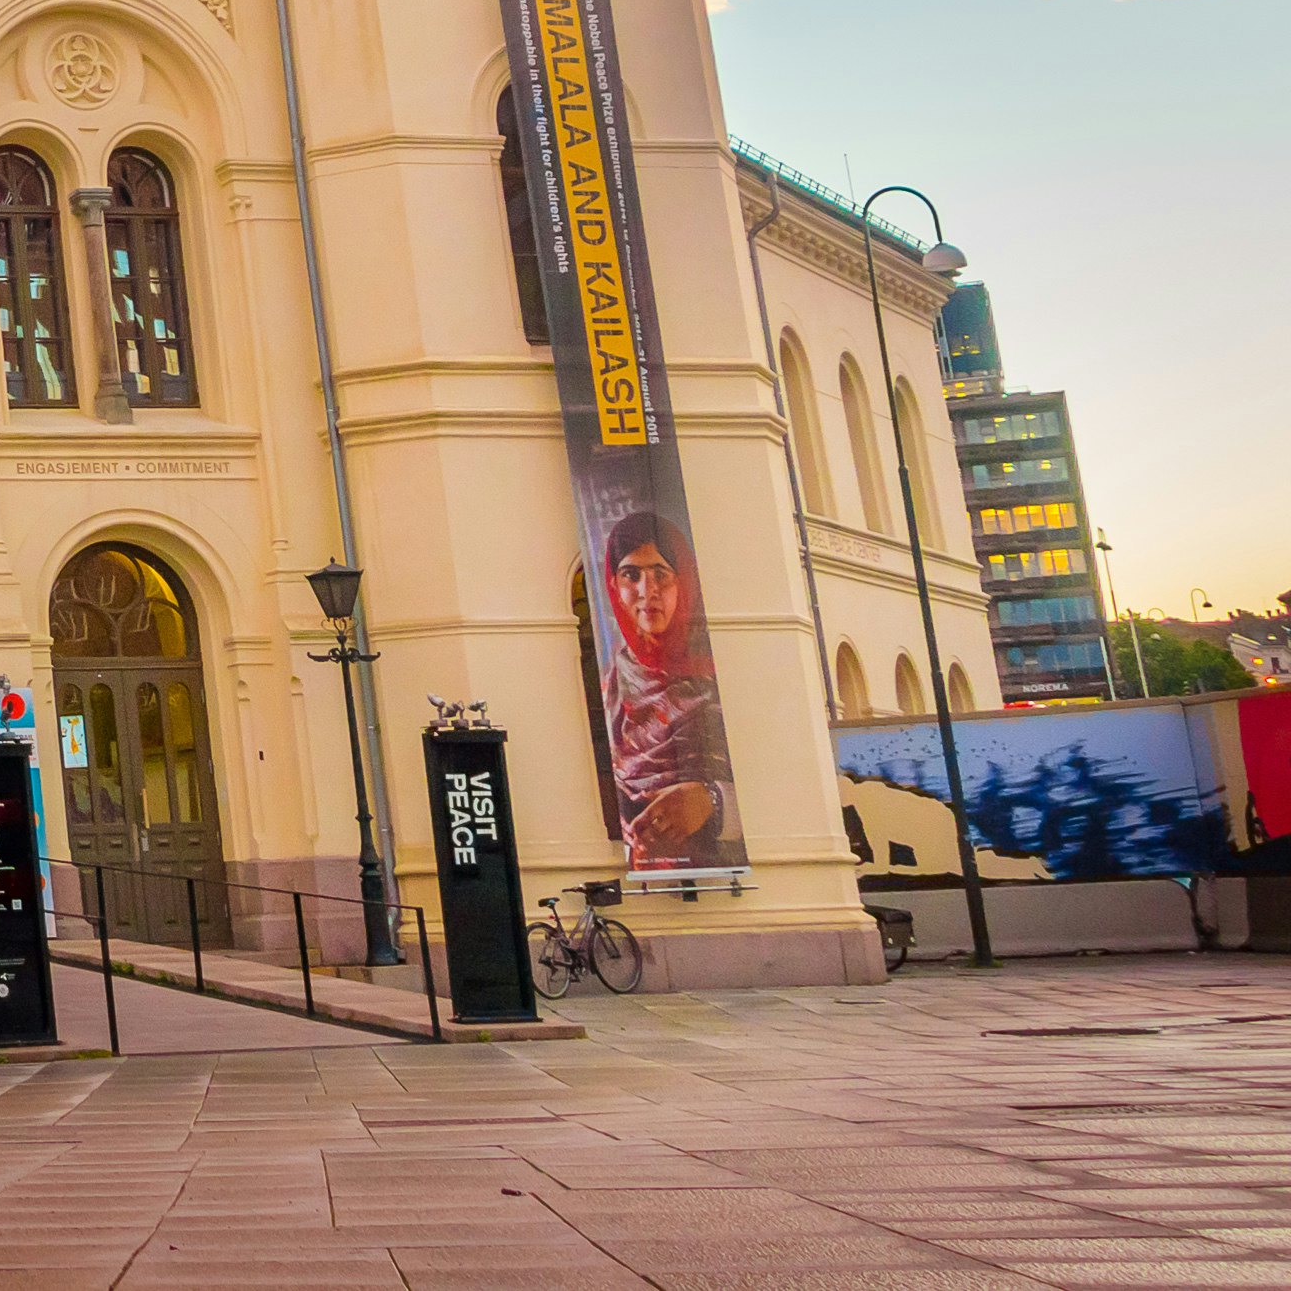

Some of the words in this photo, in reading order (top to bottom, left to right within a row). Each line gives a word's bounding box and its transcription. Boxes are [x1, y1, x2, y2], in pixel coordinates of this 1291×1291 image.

[588, 14, 601, 51] Nobel
[529, 68, 539, 80] in
[594, 53, 607, 90] Peace
[532, 83, 544, 114] their
[601, 92, 614, 125] Prize
[536, 116, 548, 147] fight
[541, 149, 552, 169] for
[568, 160, 607, 246] AND
[555, 234, 569, 274] rights
[583, 261, 641, 434] KAILASH
[639, 366, 653, 413] August
[645, 415, 659, 444] 2015
[16, 462, 119, 474] ENGASJEMENT
[136, 462, 230, 474] COMMITMENT
[445, 773, 477, 866] PEACE
[469, 772, 498, 842] VISIT
